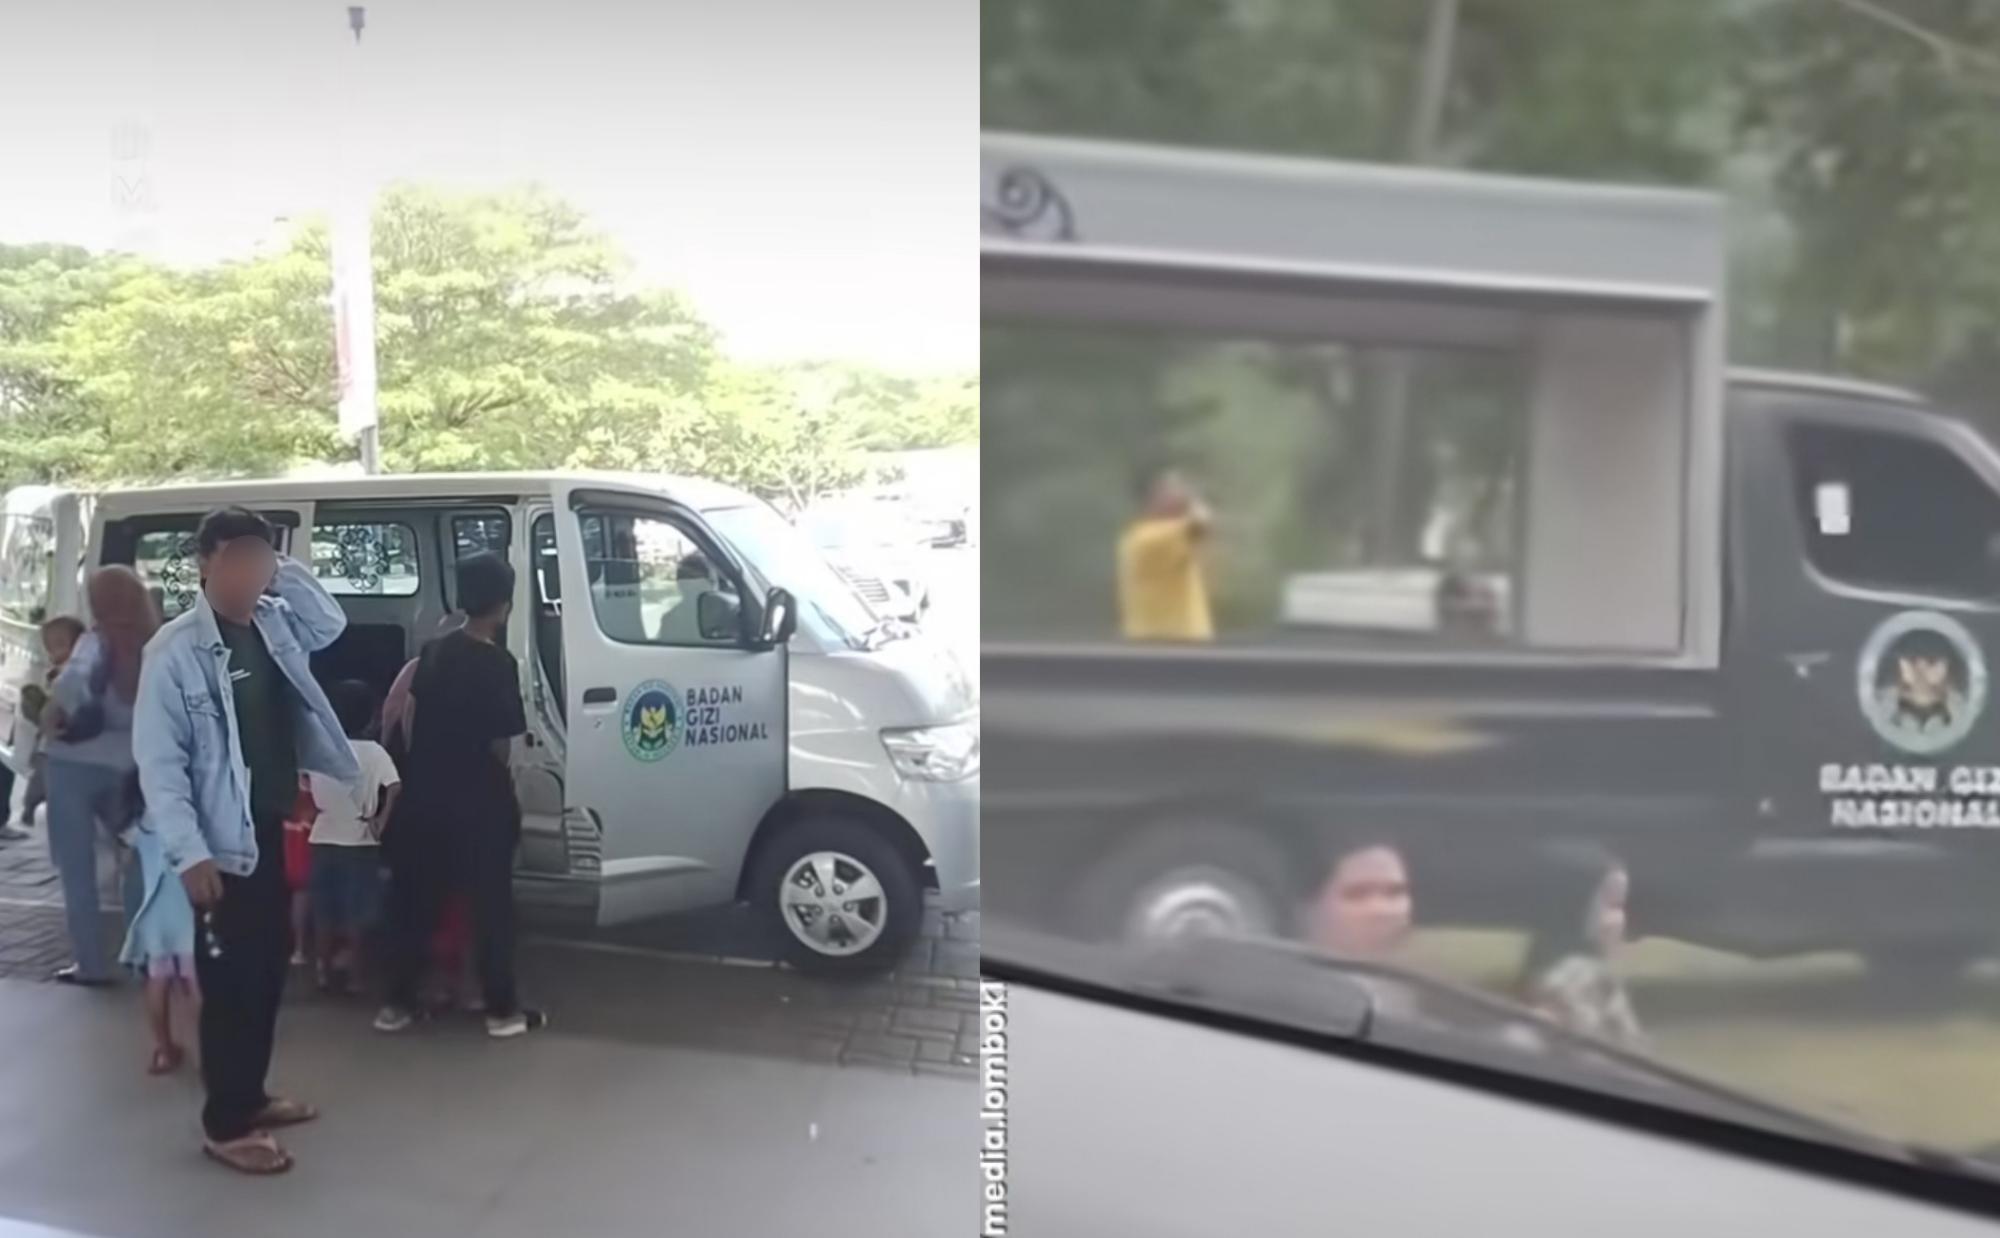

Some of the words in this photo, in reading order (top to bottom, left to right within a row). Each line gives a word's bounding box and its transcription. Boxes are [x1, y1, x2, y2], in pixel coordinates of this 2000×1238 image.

[686, 686, 743, 706] BADAN
[686, 708, 720, 726] GIZI
[685, 723, 768, 747] NASIONAL
[1819, 764, 1938, 793] BADAN
